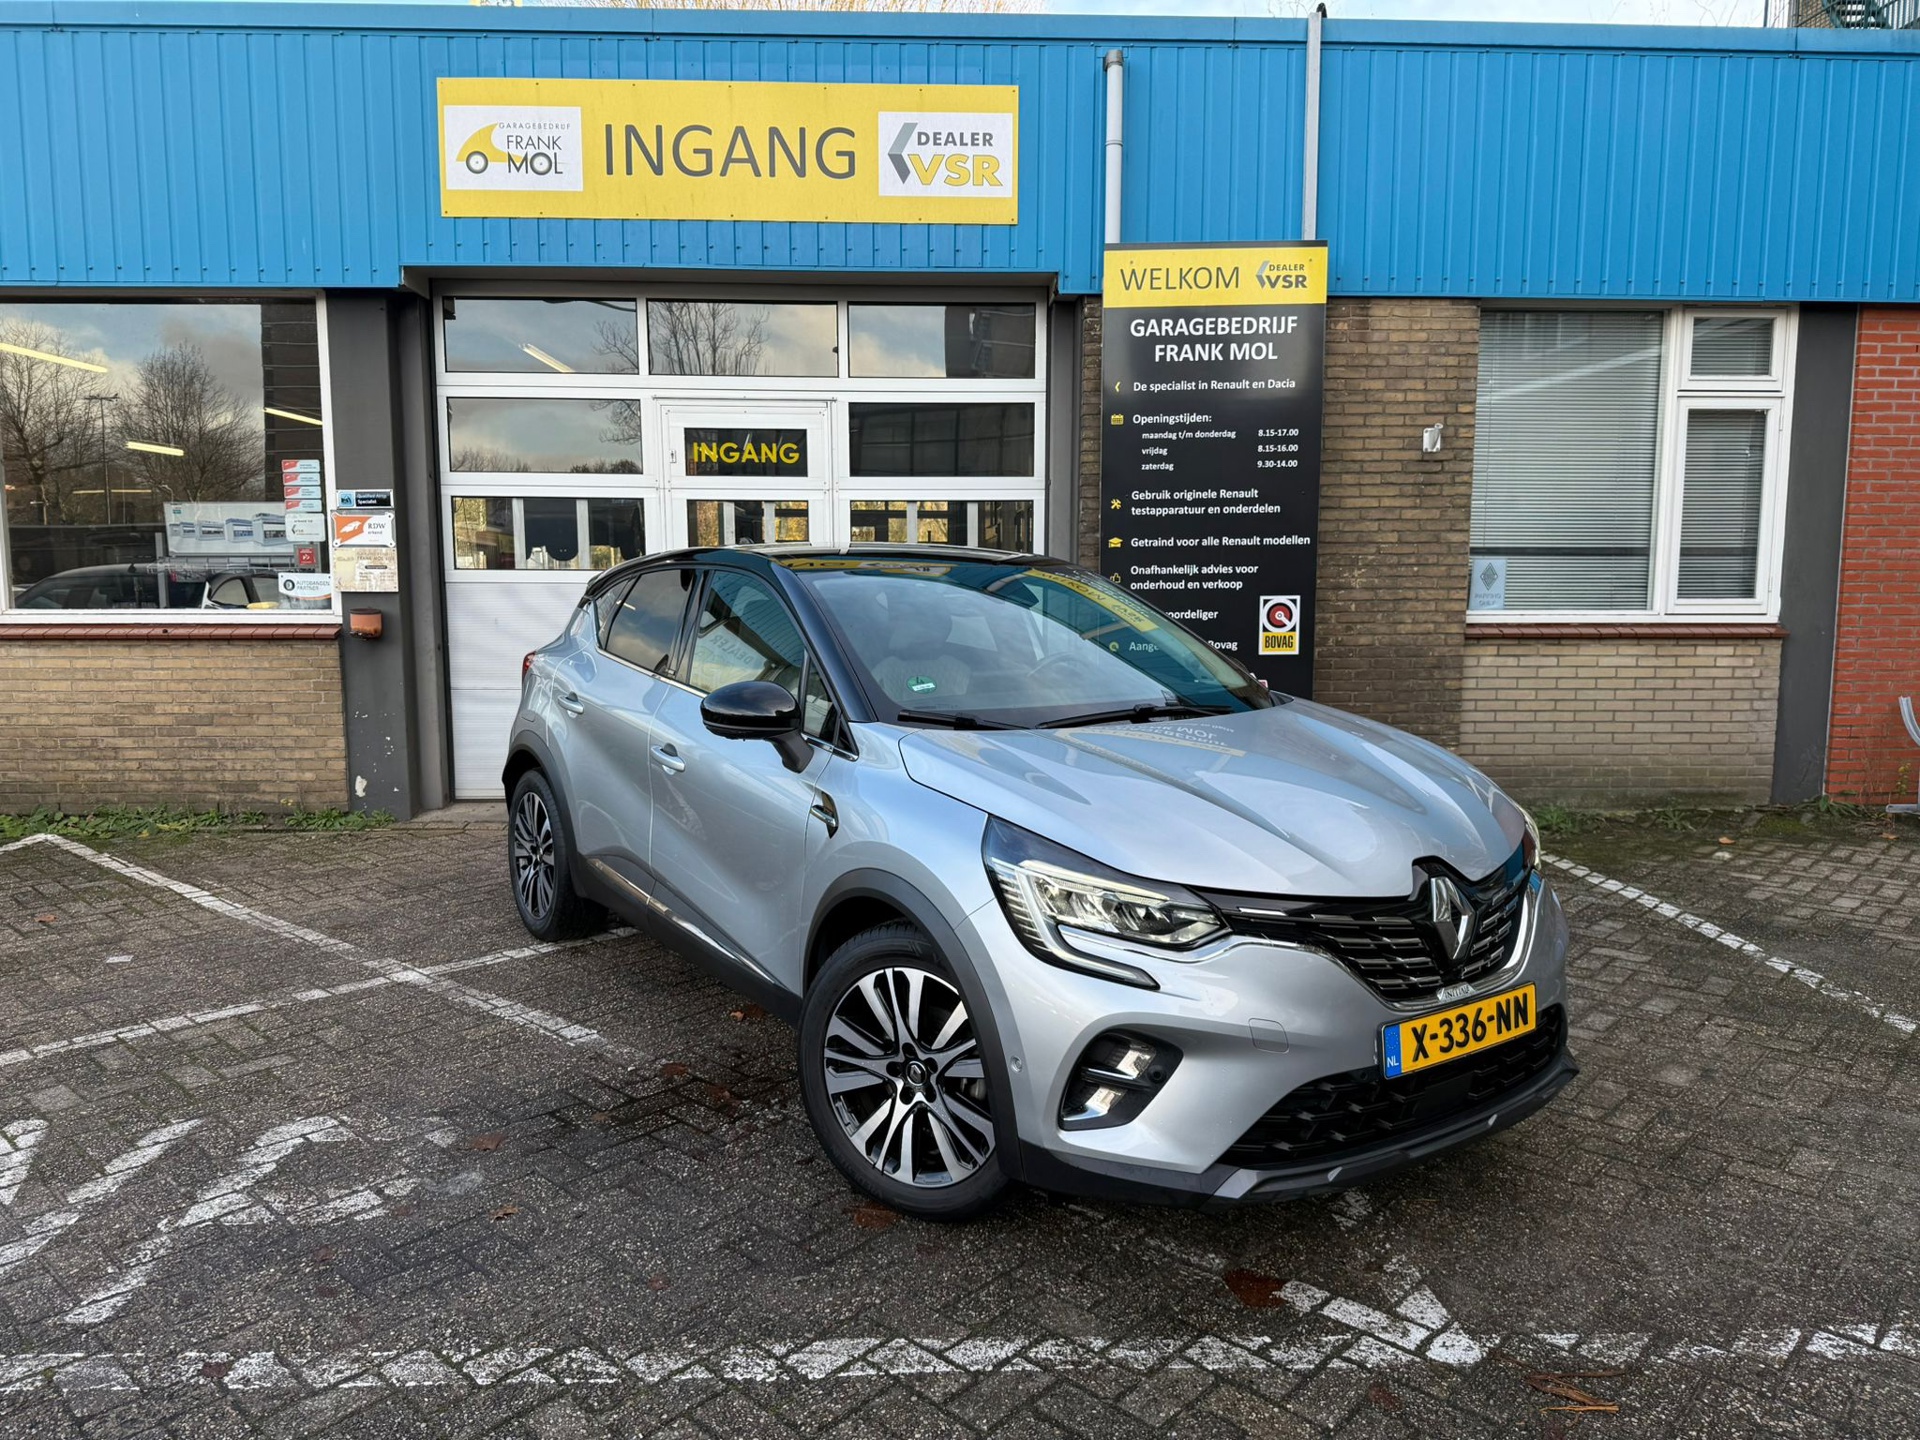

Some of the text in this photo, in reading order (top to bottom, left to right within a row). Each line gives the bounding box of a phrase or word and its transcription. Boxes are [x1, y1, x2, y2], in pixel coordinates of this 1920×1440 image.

[506, 135, 562, 151] FRANK
[917, 131, 994, 147] DEALER
[604, 124, 857, 181] INGANG
[507, 152, 563, 176] MOL
[907, 153, 1003, 187] VSR
[1268, 263, 1305, 272] DEALER
[1120, 266, 1240, 291] WELKOM
[1265, 274, 1308, 289] VSR
[1130, 316, 1298, 338] GARAGEBEDRIJF
[1154, 342, 1278, 363] FRANK MOL
[1133, 382, 1148, 392] De
[1149, 381, 1196, 393] specialist
[1198, 381, 1209, 390] in
[1210, 380, 1250, 390] Renault
[1267, 379, 1296, 389] Dacia
[1132, 413, 1212, 425] Openingstijden:
[1141, 429, 1299, 440] maandag t/m donderdag 8.15-17.00
[693, 442, 800, 464] INGANG
[1141, 444, 1299, 456] vrijdag 8.15-16.00
[1141, 460, 1298, 471] zaterdag 9.30-14.00
[1131, 489, 1259, 502] Gebruik originele Renault
[1131, 504, 1281, 518] testapparatuur en onderdelen
[1130, 535, 1311, 547] Getraind voor alle Renault modellen
[1130, 565, 1199, 577] Onafhankelijk
[1201, 564, 1234, 574] advies
[1130, 580, 1243, 591] onderhoud en verkoop
[1166, 609, 1219, 621] oordeliger
[1264, 634, 1294, 649] BOVAG
[1387, 992, 1529, 1069] NL X-336-NN
